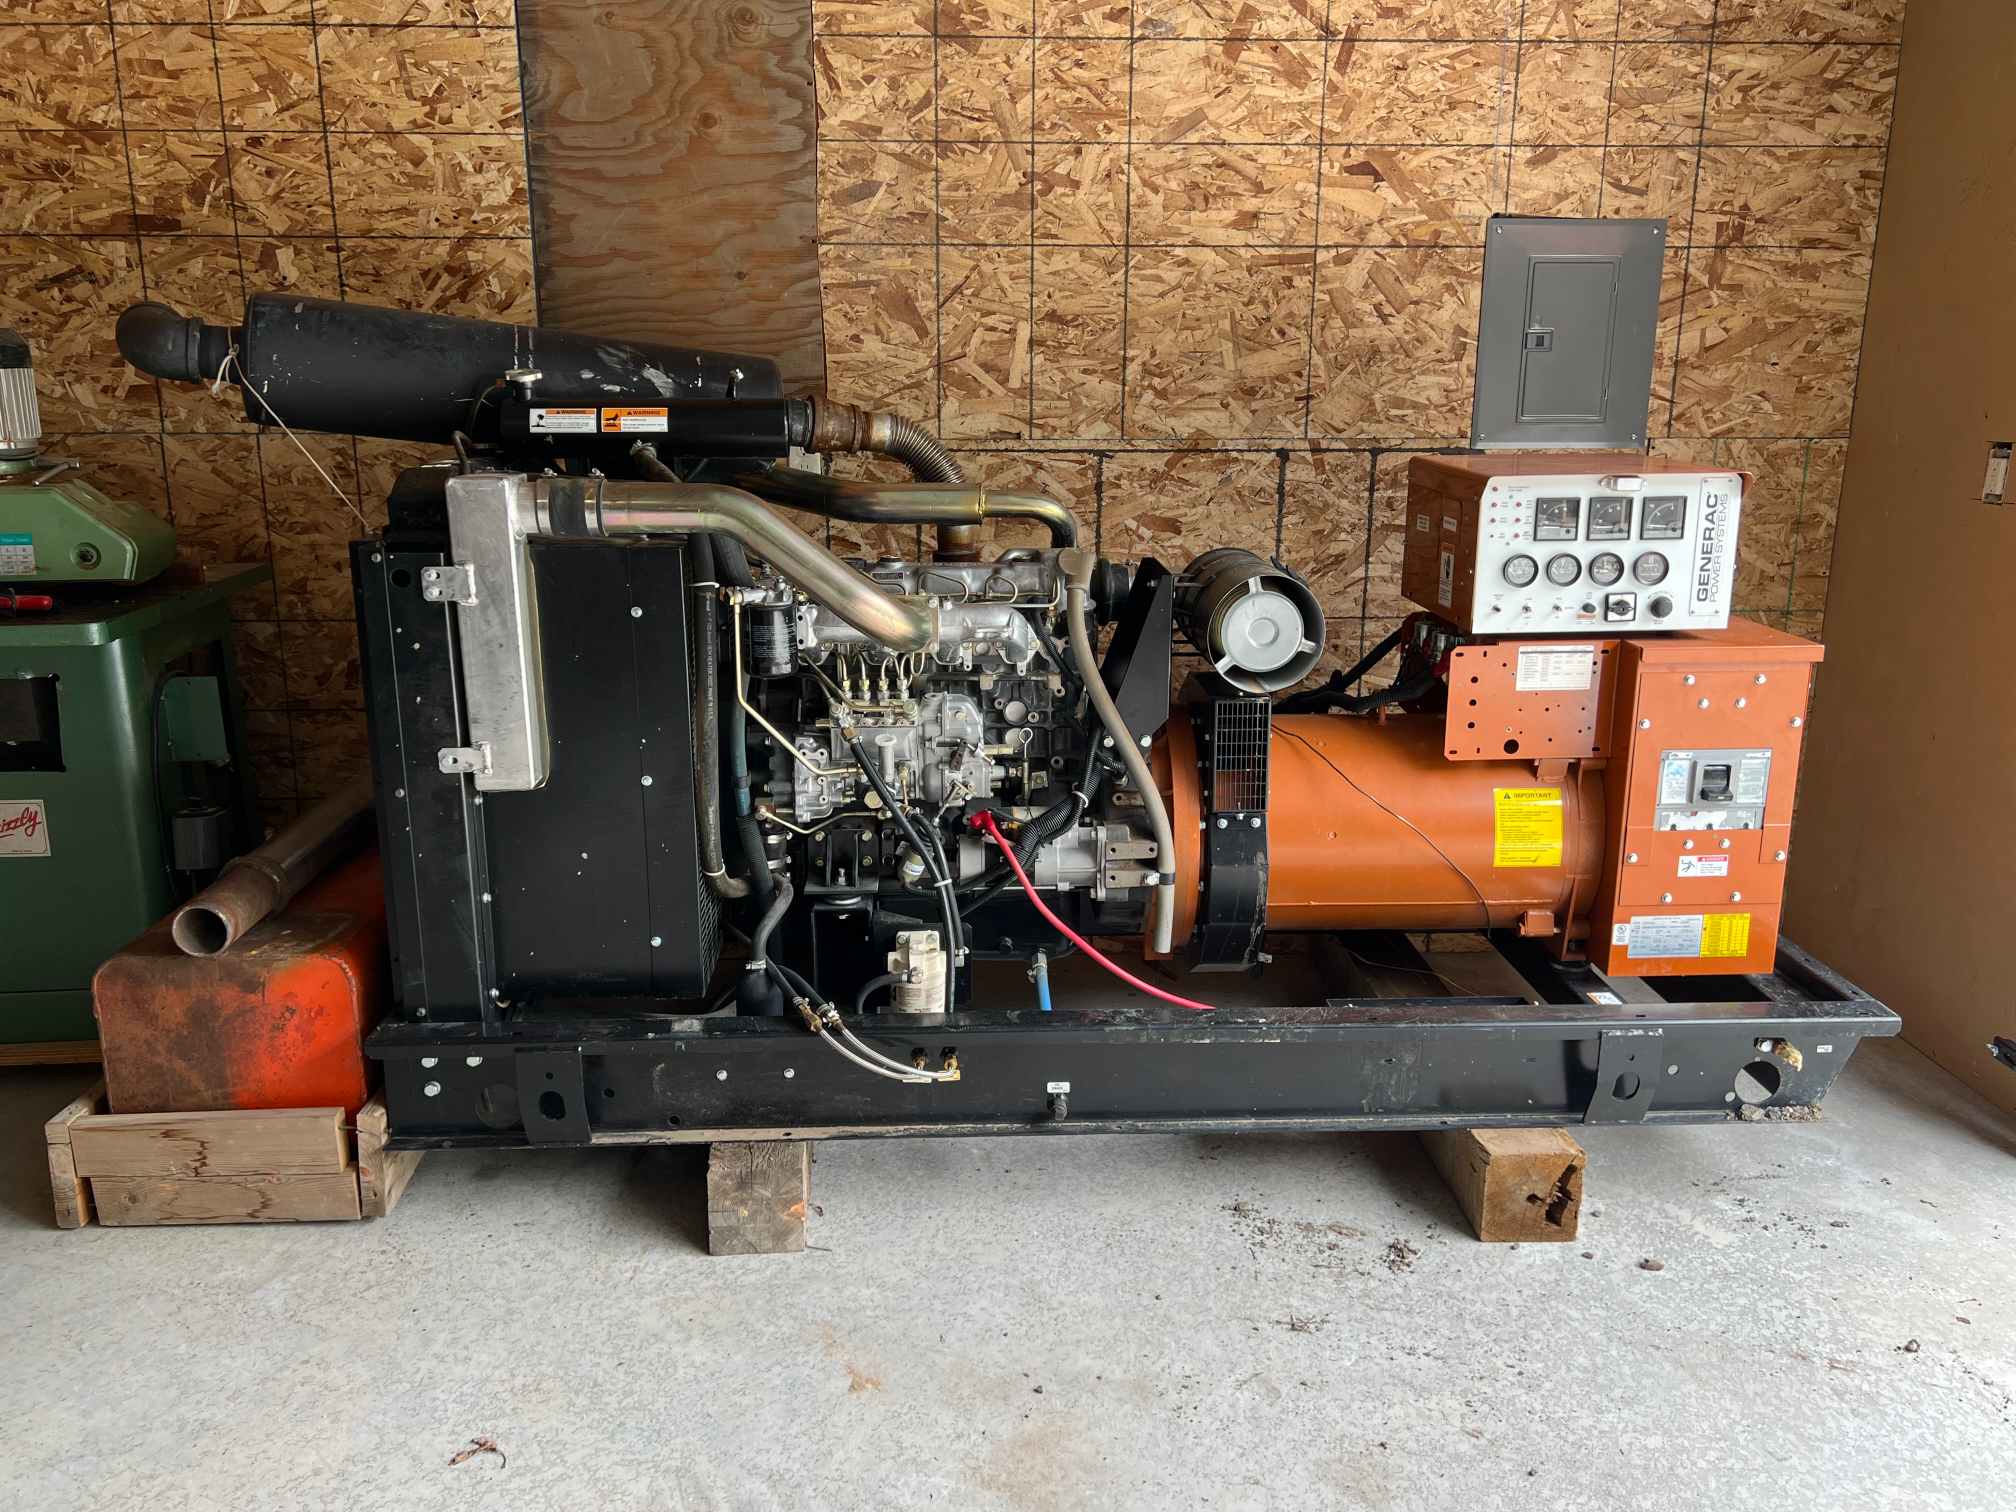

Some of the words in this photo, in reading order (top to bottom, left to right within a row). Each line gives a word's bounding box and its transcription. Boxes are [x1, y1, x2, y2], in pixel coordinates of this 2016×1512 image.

[1696, 493, 1718, 603] GENERAC
[1714, 493, 1729, 554] SYSTEMS
[1709, 554, 1722, 603] POWER
